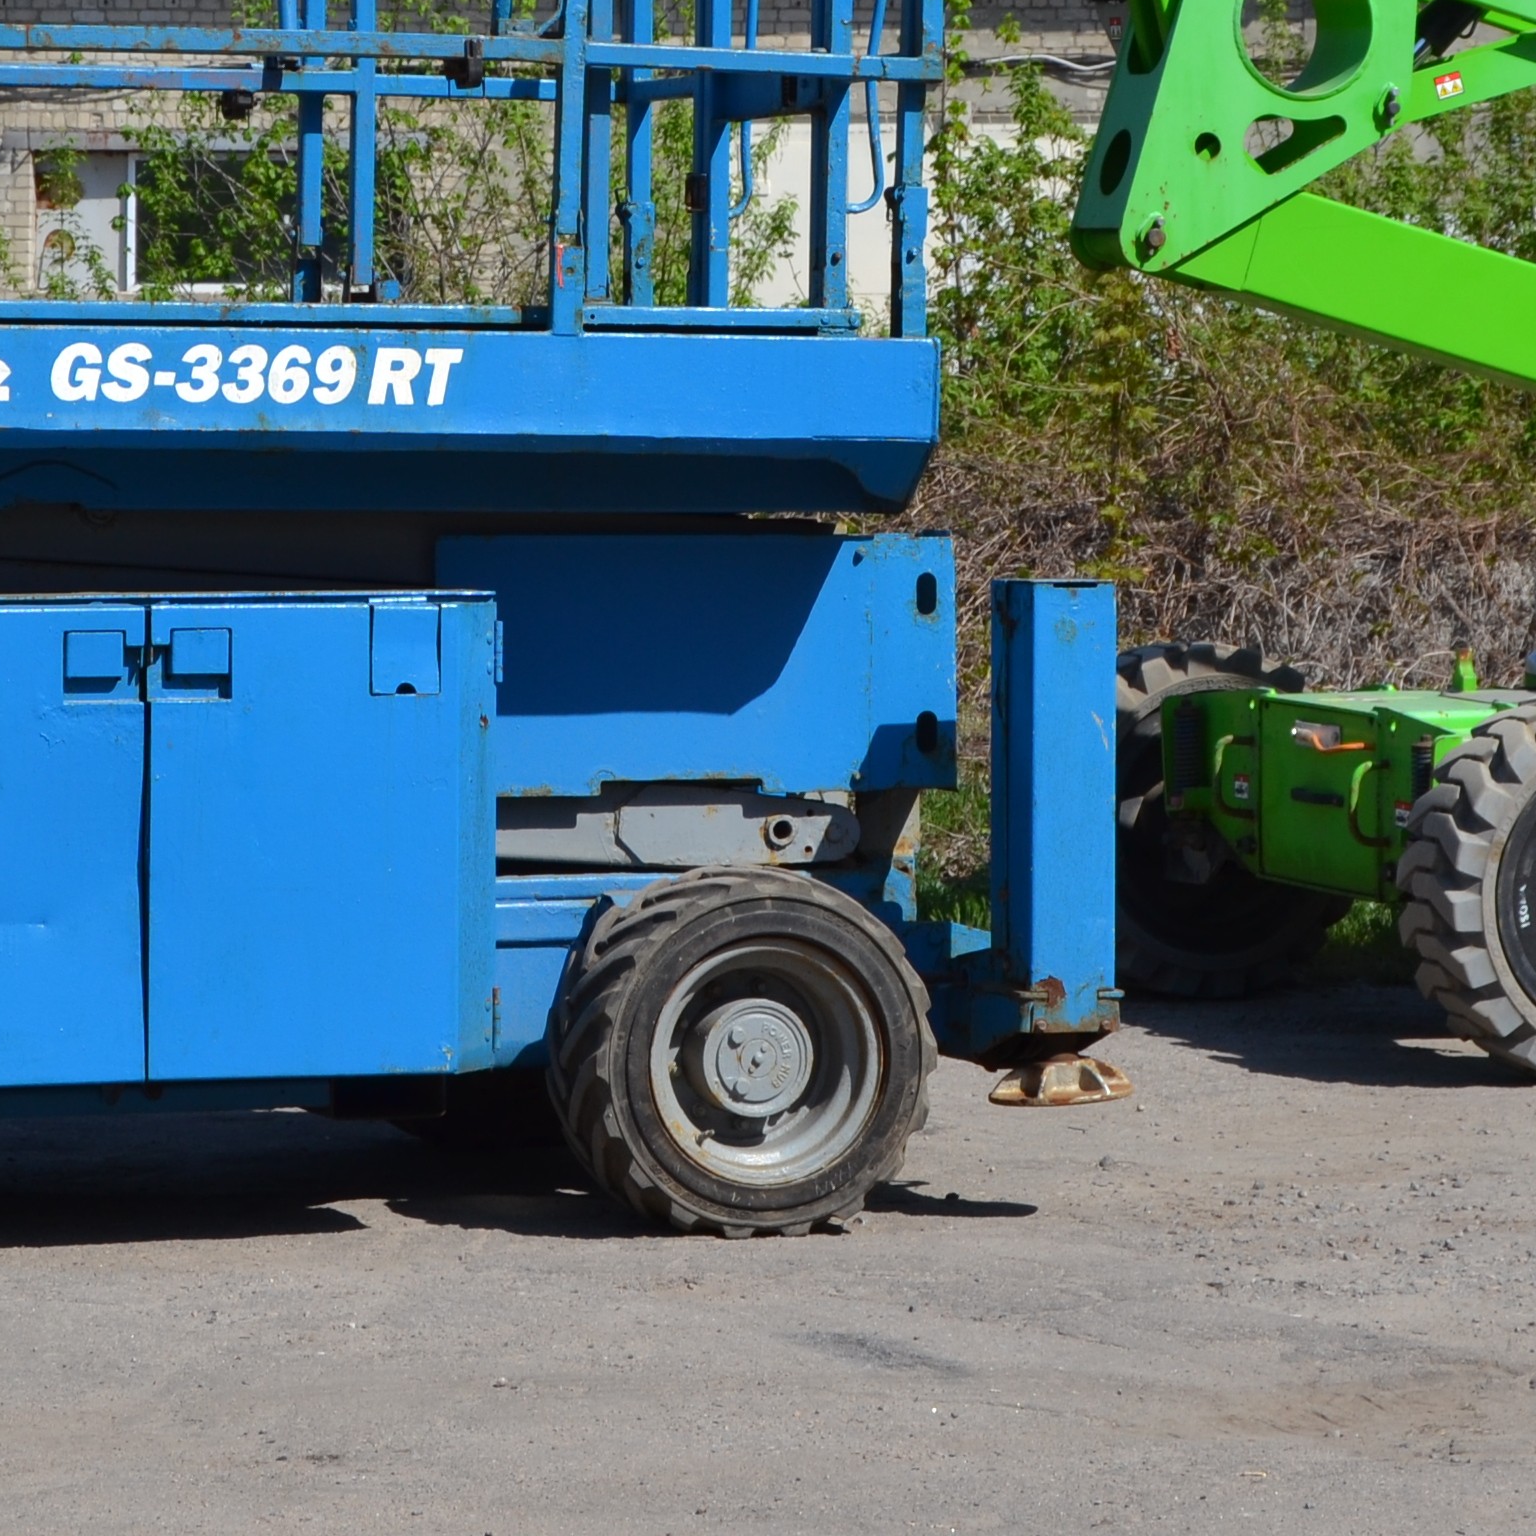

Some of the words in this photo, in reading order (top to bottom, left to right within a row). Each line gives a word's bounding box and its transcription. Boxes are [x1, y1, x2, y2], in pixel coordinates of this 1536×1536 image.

[50, 342, 354, 405] GS-3369
[367, 347, 463, 406] RT
[760, 1021, 792, 1060] POWER
[771, 1064, 792, 1089] HUB
